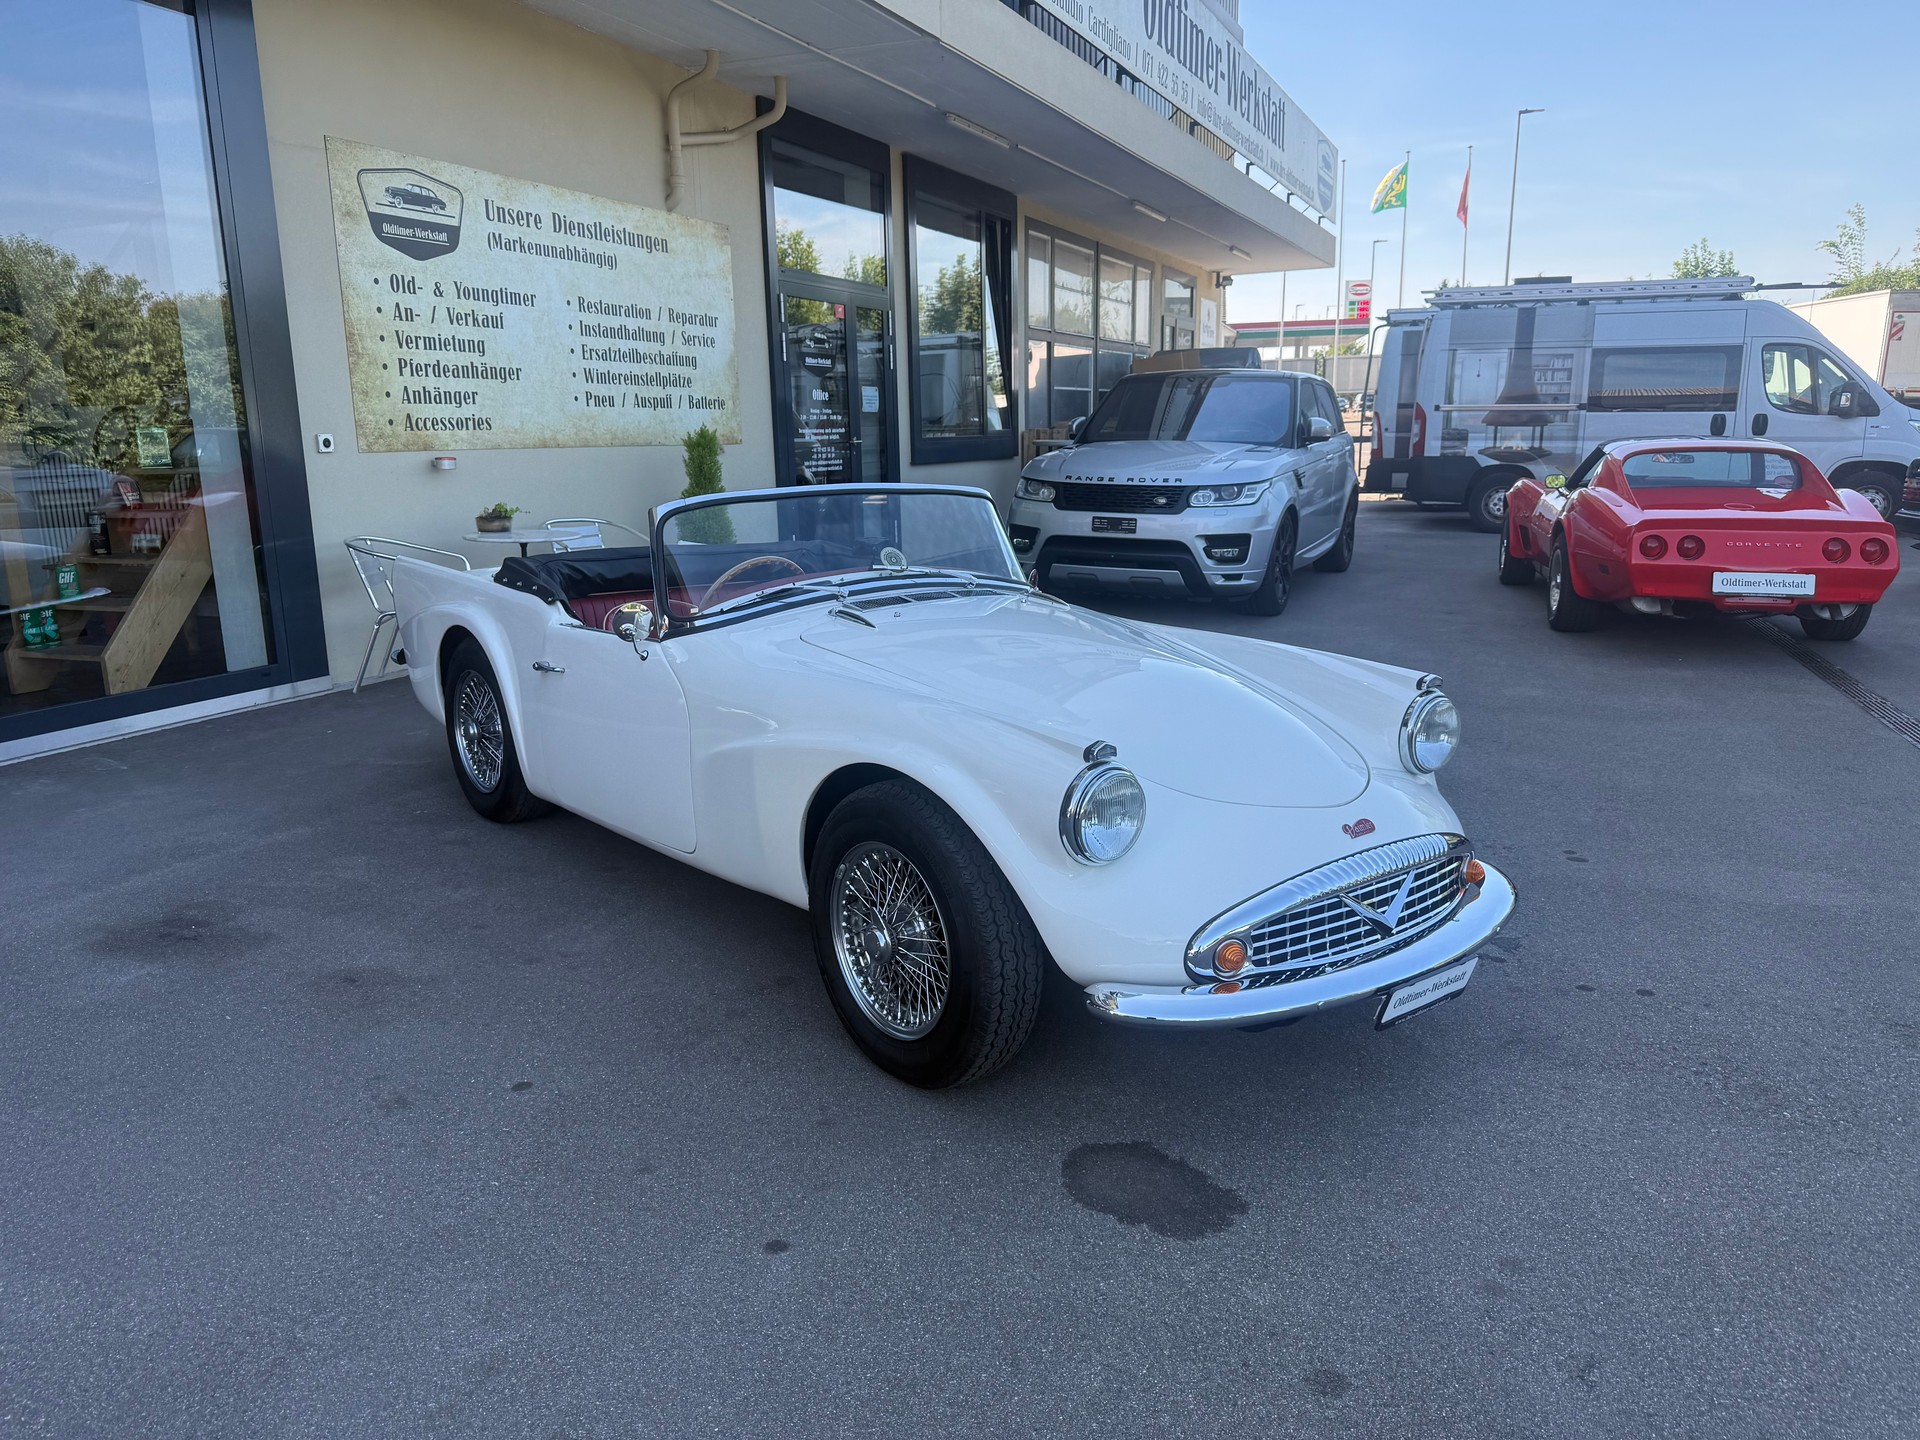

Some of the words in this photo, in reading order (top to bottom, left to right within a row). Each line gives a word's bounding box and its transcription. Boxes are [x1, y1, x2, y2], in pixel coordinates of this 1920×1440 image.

[1088, 5, 1132, 61] Cardigliano
[1142, 49, 1153, 78] 071
[1158, 61, 1168, 89] 422
[382, 222, 448, 242] Oldtimer-Werkstatt
[484, 199, 543, 230] Unsere
[552, 212, 669, 253] Dienstleistungen
[487, 231, 617, 271] (Markenunabhängig)
[389, 273, 423, 295] Old-
[433, 281, 444, 298] &
[453, 280, 537, 307] Youngtimer
[393, 302, 421, 322] An-
[446, 306, 504, 329] Verkauf
[577, 295, 652, 321] Restauration
[668, 307, 719, 328] Reparatur
[394, 329, 486, 357] Vermietung
[579, 320, 666, 346] Instandhaltung
[681, 330, 716, 348] Service
[397, 357, 522, 384] Pferdeanhänger
[581, 344, 697, 370] Ersatzteilbeschaffung
[583, 367, 693, 390] Wintereinstellplätze
[401, 385, 478, 408] Anhänger
[585, 390, 615, 408] Pneu
[633, 393, 673, 411] Auspuff
[688, 394, 726, 410] Batterie
[812, 388, 829, 401] Office
[404, 412, 492, 432] Accessories
[1721, 577, 1807, 589] Oldtimer-Werkstatt
[1393, 970, 1468, 1009] Oldtimer-Werkstatt
